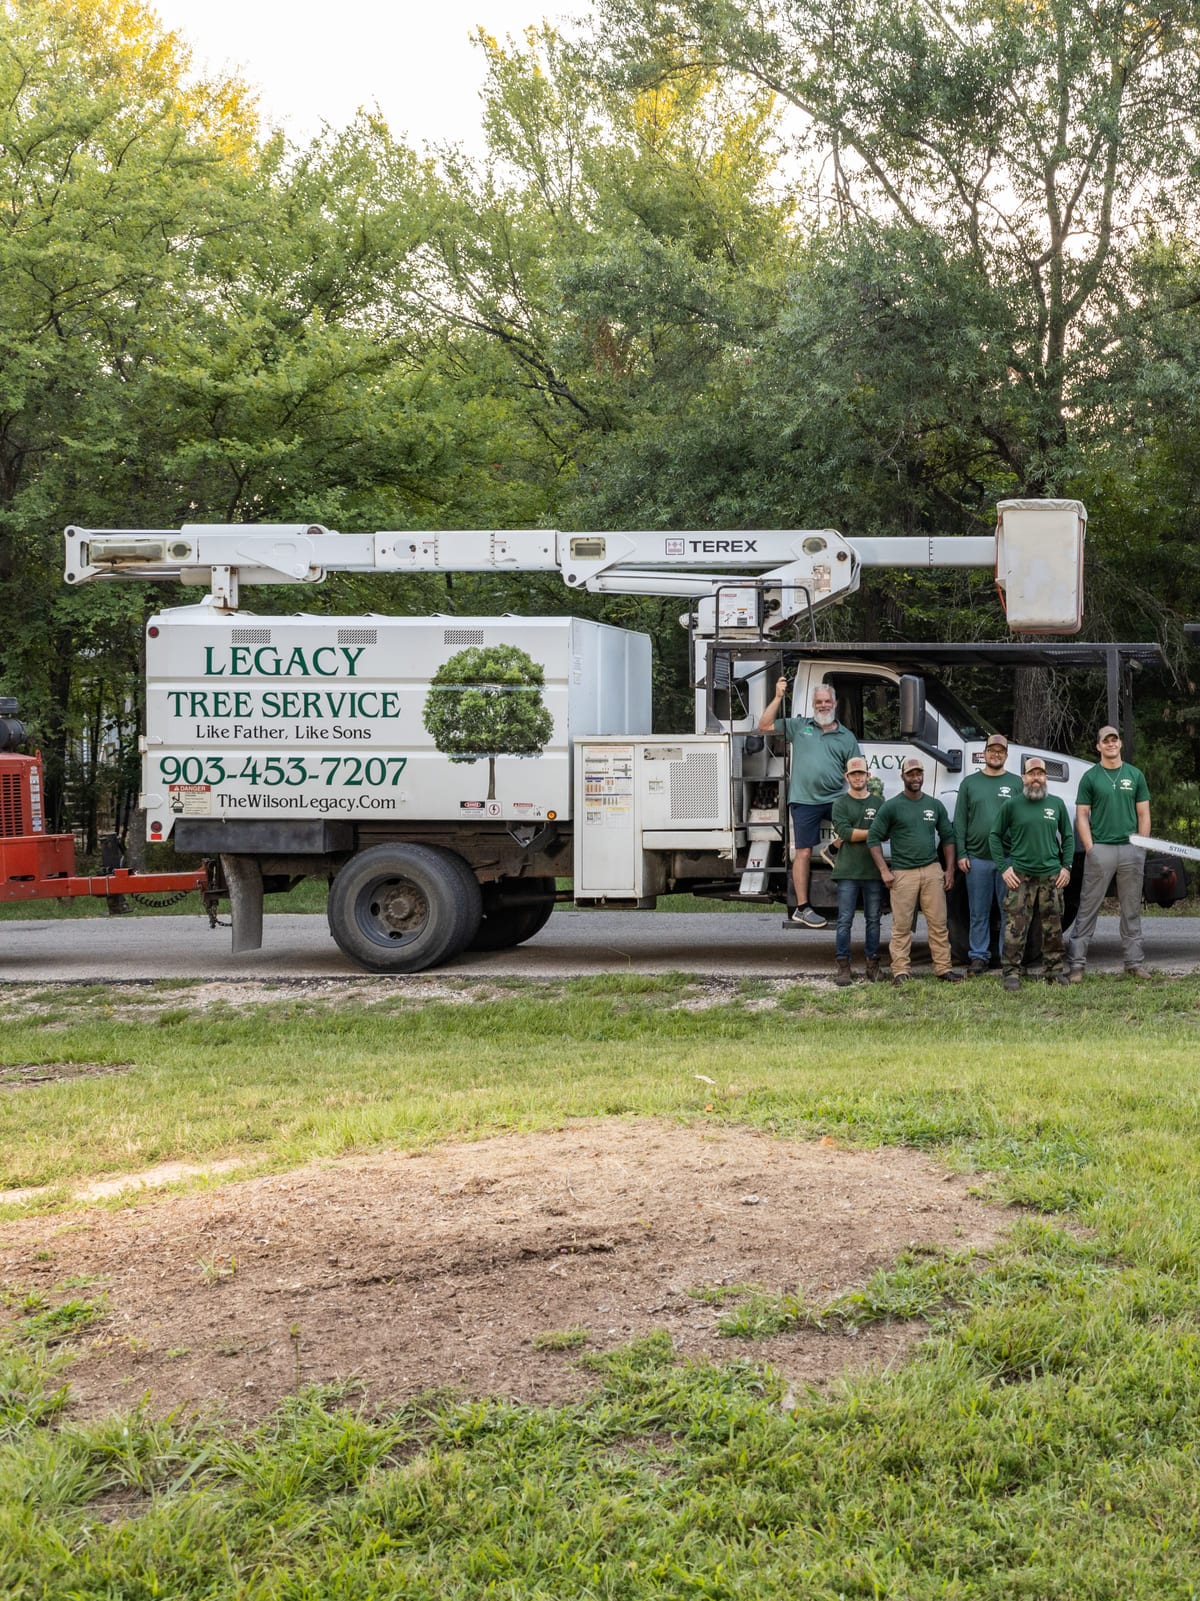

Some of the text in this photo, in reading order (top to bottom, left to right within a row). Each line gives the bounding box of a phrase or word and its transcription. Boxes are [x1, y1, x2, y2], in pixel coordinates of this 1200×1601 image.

[688, 540, 758, 553] TEREX
[203, 646, 366, 676] LEGACY
[167, 691, 401, 718] TREE SERVICE
[196, 725, 371, 740] Like Father, Like Sons
[160, 756, 407, 786] 903-453-7207
[217, 794, 396, 812] TheWilsonLegacy.Com
[1169, 845, 1189, 855] STIHL
